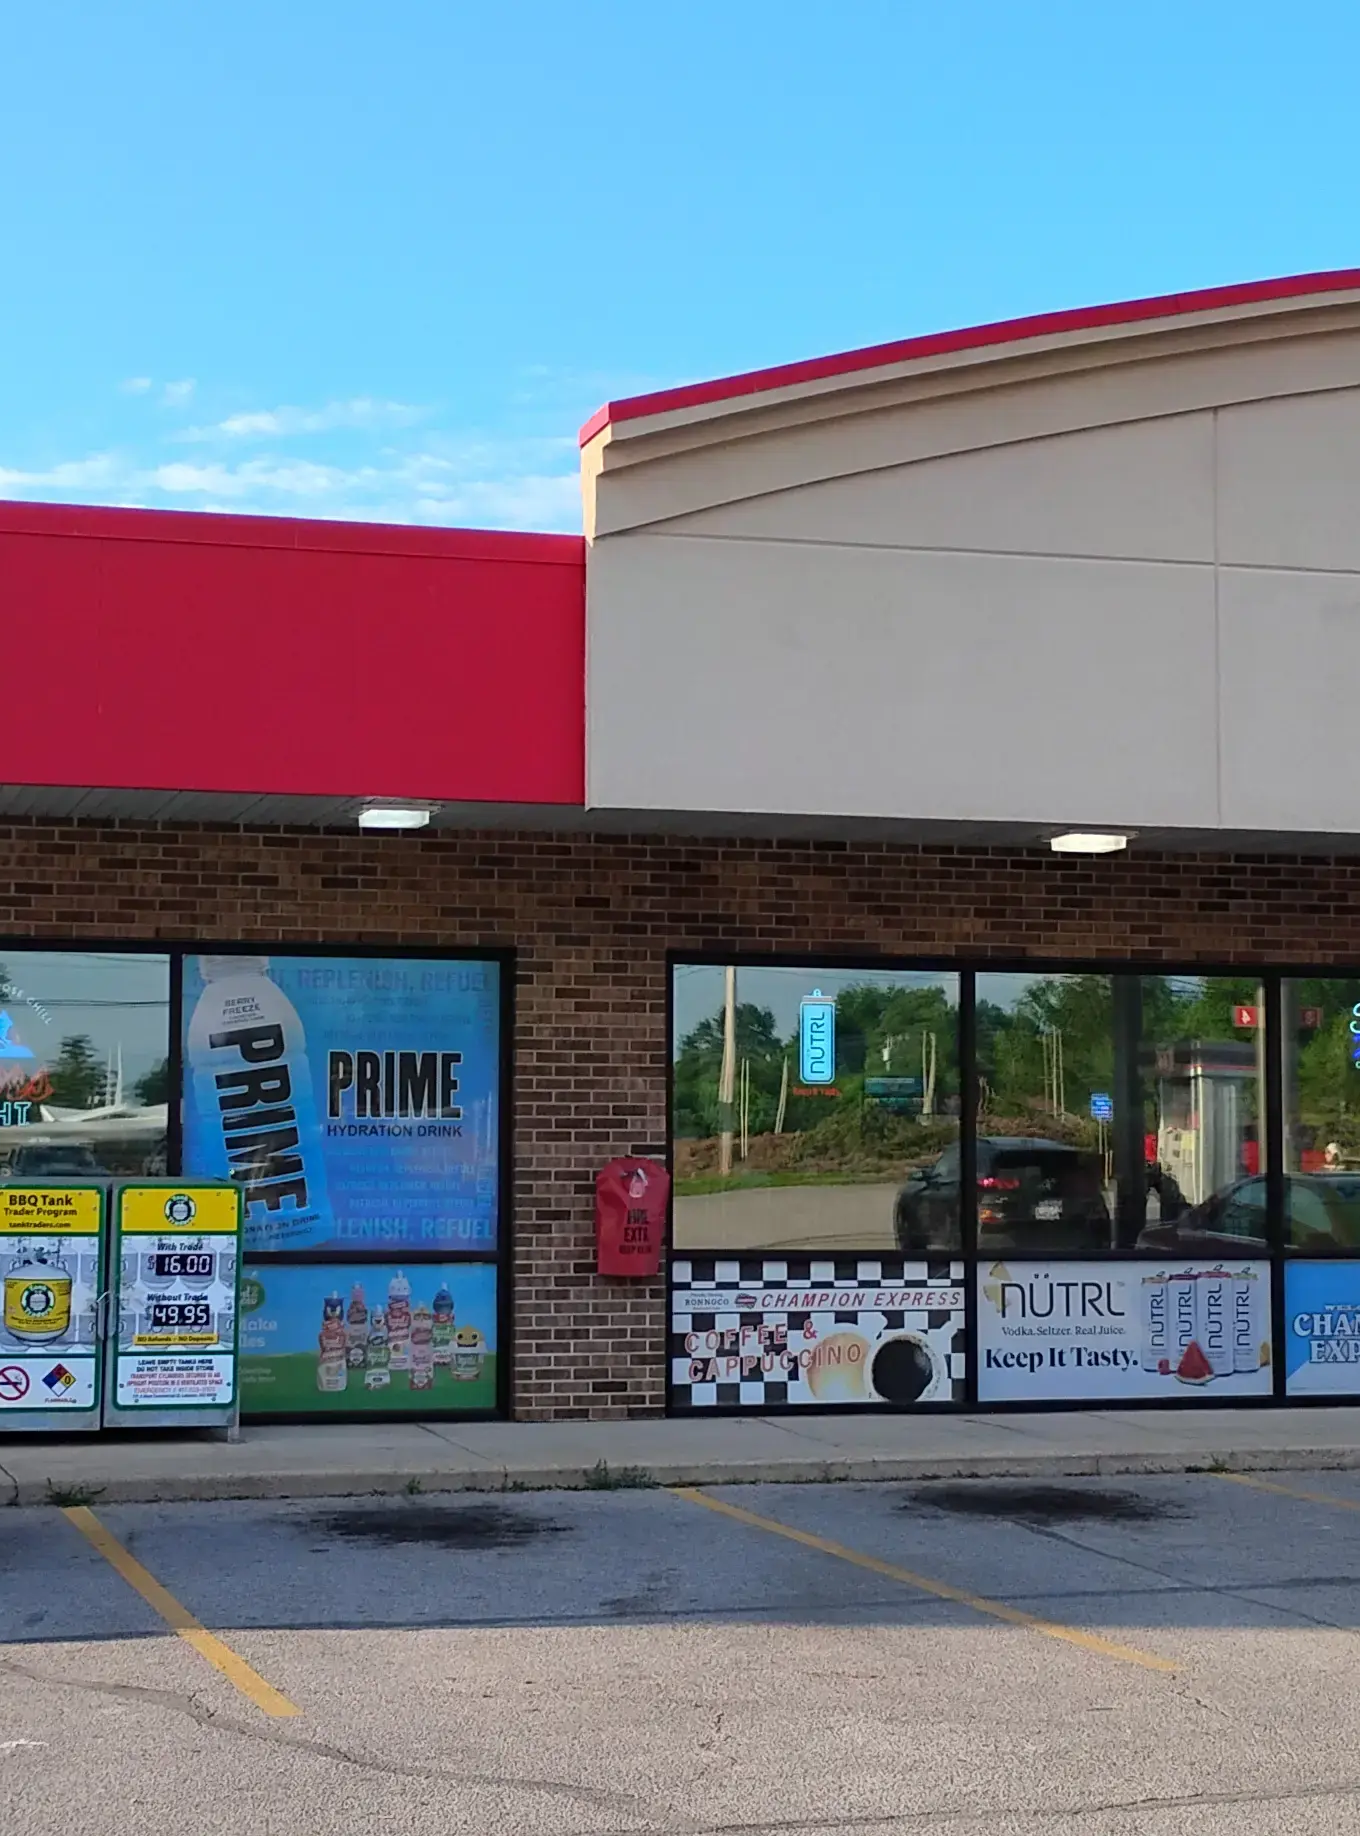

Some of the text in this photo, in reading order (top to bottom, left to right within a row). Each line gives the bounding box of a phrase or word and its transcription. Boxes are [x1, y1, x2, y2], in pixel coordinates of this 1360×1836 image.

[26, 997, 53, 1025] CHILL
[223, 1004, 260, 1015] FREEZE
[328, 1050, 463, 1119] PRIME
[209, 1023, 309, 1218] PRIME
[327, 1125, 462, 1137] HYDRATION DRINK
[9, 1194, 72, 1207] BBQ Tank
[4, 1207, 77, 1217] Trader Program
[9, 1221, 71, 1229] tanktraders.com
[158, 1242, 203, 1251] With Trade
[147, 1293, 208, 1302] Without Trade
[761, 1291, 961, 1308] CHAMPION EXPRESS
[685, 1319, 818, 1354] COFFEE &
[1002, 1326, 1126, 1336] Vodka. Seltzer. Real Juice.
[688, 1343, 862, 1382] CAPPUCCINO
[986, 1347, 1138, 1373] Keep It Tasty.
[64, 1375, 71, 1385] 0
